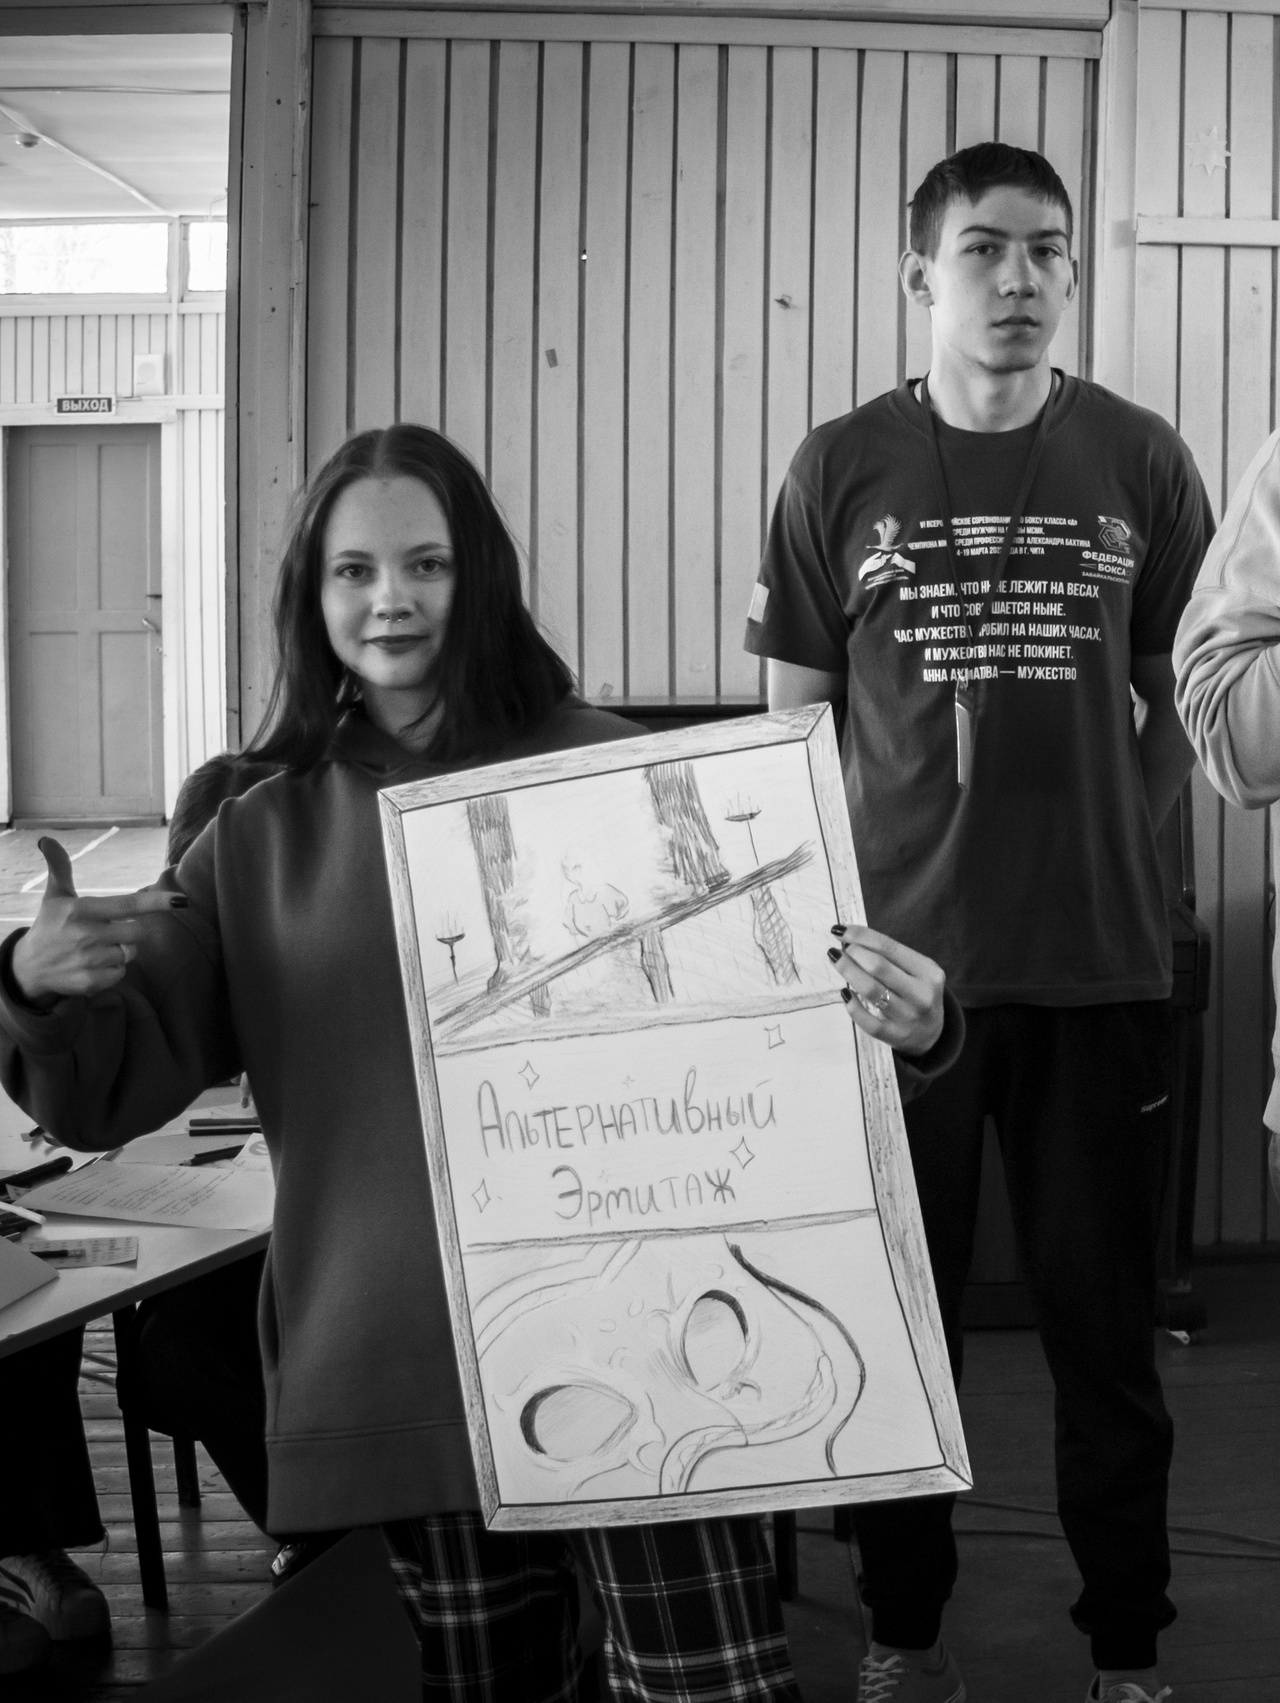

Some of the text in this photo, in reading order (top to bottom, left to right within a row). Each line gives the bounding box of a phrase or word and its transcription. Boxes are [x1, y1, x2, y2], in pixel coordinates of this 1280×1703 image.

[62, 399, 109, 412] ВЫХОД
[971, 516, 1012, 525] СОРЕВНОВАНИ
[1026, 536, 1065, 546] АЛЕКСАНДРА
[1065, 538, 1091, 548] БАХТИНА
[970, 546, 989, 556] МАРТА
[1098, 563, 1126, 576] БОКСА
[900, 586, 918, 600] МЫ
[919, 583, 958, 599] ЗНАЕМ,
[961, 581, 980, 595] ЧТО
[1009, 580, 1048, 594] ЛЕЖИТ
[1050, 581, 1065, 595] НА
[1067, 582, 1100, 598] ВЕСАХ
[931, 602, 1067, 619] И ЧТО СОВШАЕТСЯ НЫНЕ.
[894, 629, 914, 643] ЧАС
[1012, 623, 1026, 636] НА
[1029, 623, 1067, 638] НАШИХ
[1069, 624, 1102, 642] ЧАСАХ,
[925, 647, 932, 661] И
[988, 644, 1006, 658] НАС
[1008, 644, 1022, 658] НЕ
[1024, 644, 1074, 659] ПОКИНЕТ.
[923, 668, 948, 682] АННА
[1018, 665, 1077, 680] МУЖЕСТВО
